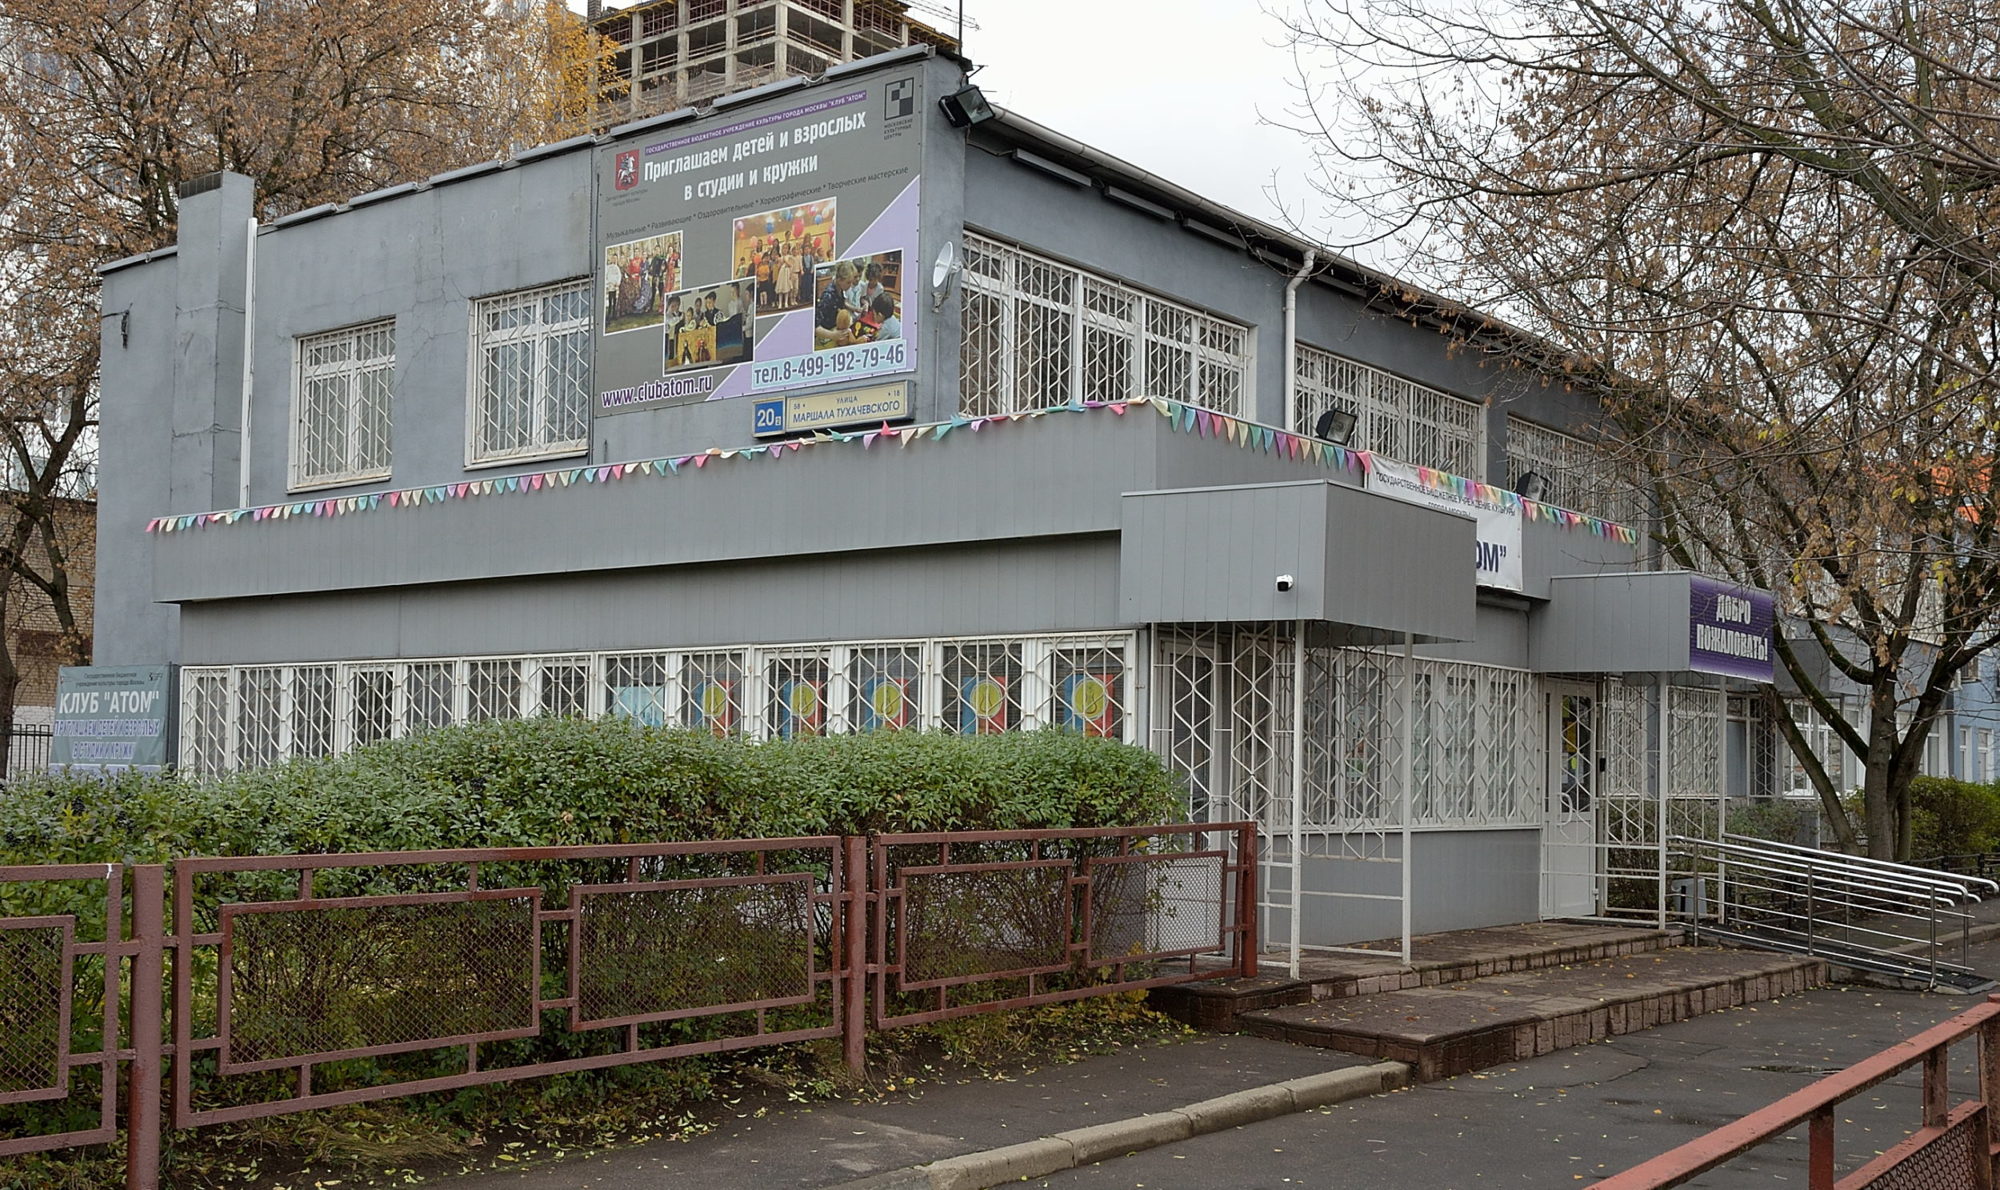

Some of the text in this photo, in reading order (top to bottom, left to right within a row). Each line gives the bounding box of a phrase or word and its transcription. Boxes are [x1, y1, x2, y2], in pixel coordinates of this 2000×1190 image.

[691, 129, 722, 143] БЮДЖЕТНОЕ
[722, 121, 755, 135] УЧРЕЖДЕНИЕ
[756, 113, 782, 126] КУЛЬТУРЫ
[782, 107, 804, 119] ГОРОДА
[804, 102, 828, 113] МОСКВЫ
[644, 111, 866, 182] Приглашаем детей и взрослых
[684, 154, 818, 201] в студии и кружки
[606, 166, 909, 240] Музыкальные Развивающие Оздоровительные Хореографические Творческие мастерские
[753, 342, 905, 385] тел.8-499-192-79-46
[602, 374, 713, 408] www.clubatom.ru
[836, 395, 858, 404] УЛИЦА
[793, 400, 900, 424] МАРШАЛА ТУХАЧЕВСКОГО
[1716, 593, 1752, 624] ДОБРО
[1696, 623, 1768, 661] ПОЖАЛОВАТЬ!
[59, 690, 160, 714] КЛУБ "АТОМ"
